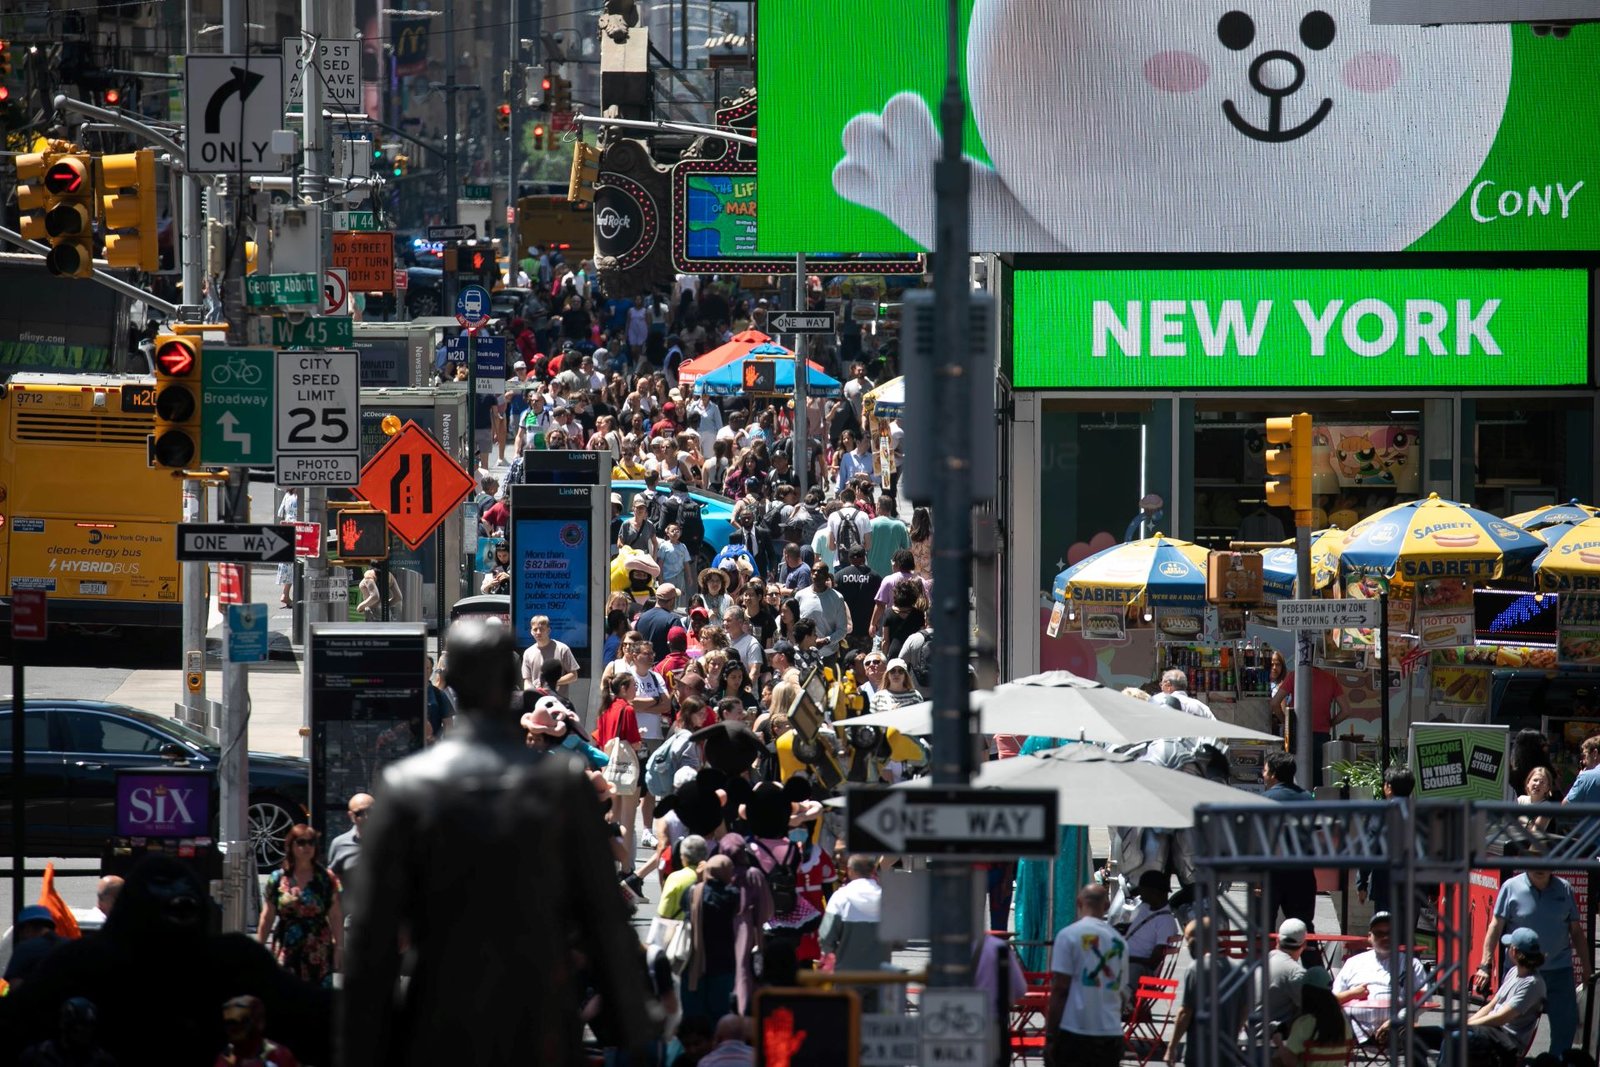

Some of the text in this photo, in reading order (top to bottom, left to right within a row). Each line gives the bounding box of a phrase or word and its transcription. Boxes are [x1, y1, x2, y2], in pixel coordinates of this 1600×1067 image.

[334, 46, 350, 56] ST
[296, 58, 350, 70] CSED
[327, 74, 354, 84] AVE
[328, 88, 354, 98] SUN
[201, 141, 269, 164] ONLY
[714, 184, 732, 193] THE
[726, 201, 757, 217] MAR
[350, 214, 374, 228] W 44
[608, 214, 630, 228] Rock
[352, 242, 386, 254] STREET
[336, 256, 388, 268] LEFT TURN
[374, 271, 386, 281] ST
[248, 276, 314, 296] George Abbott
[778, 318, 826, 328] ONE WAY
[1091, 298, 1504, 358] NEW YORK
[278, 320, 349, 343] W 45 St
[448, 338, 460, 348] M7
[448, 351, 464, 361] M20
[300, 358, 332, 370] CITY
[292, 373, 340, 386] SPEED
[17, 393, 42, 404] 9712
[204, 392, 268, 407] Broadway
[298, 390, 336, 402] LIMIT
[288, 408, 350, 444] 25
[296, 460, 339, 470] PHOTO
[284, 470, 352, 482] ENFORCED
[1413, 522, 1473, 539] SABRETT
[136, 535, 148, 543] City
[194, 536, 278, 551] ONE WAY
[47, 545, 142, 558] clean-energy bus
[1562, 542, 1600, 554] SABR
[60, 560, 140, 574] HYBRIDBUS
[525, 560, 567, 569] $82 billion
[1404, 559, 1497, 576] SABRETT
[525, 571, 571, 579] contributed
[842, 574, 870, 584] DOUGH
[1544, 574, 1600, 590] SABR
[1282, 603, 1367, 613] PEDESTRIAN FLOW ZONE
[1282, 616, 1329, 625] KEEP MOVING
[1424, 617, 1442, 625] HOT
[1420, 740, 1461, 756] EXPLORE
[1422, 754, 1448, 767] MORE
[1473, 751, 1493, 763] 45TH
[1422, 763, 1462, 778] IN TIMES
[1471, 760, 1498, 774] STREET
[1424, 774, 1462, 790] SQUARE
[879, 808, 1031, 834] ONE WAY
